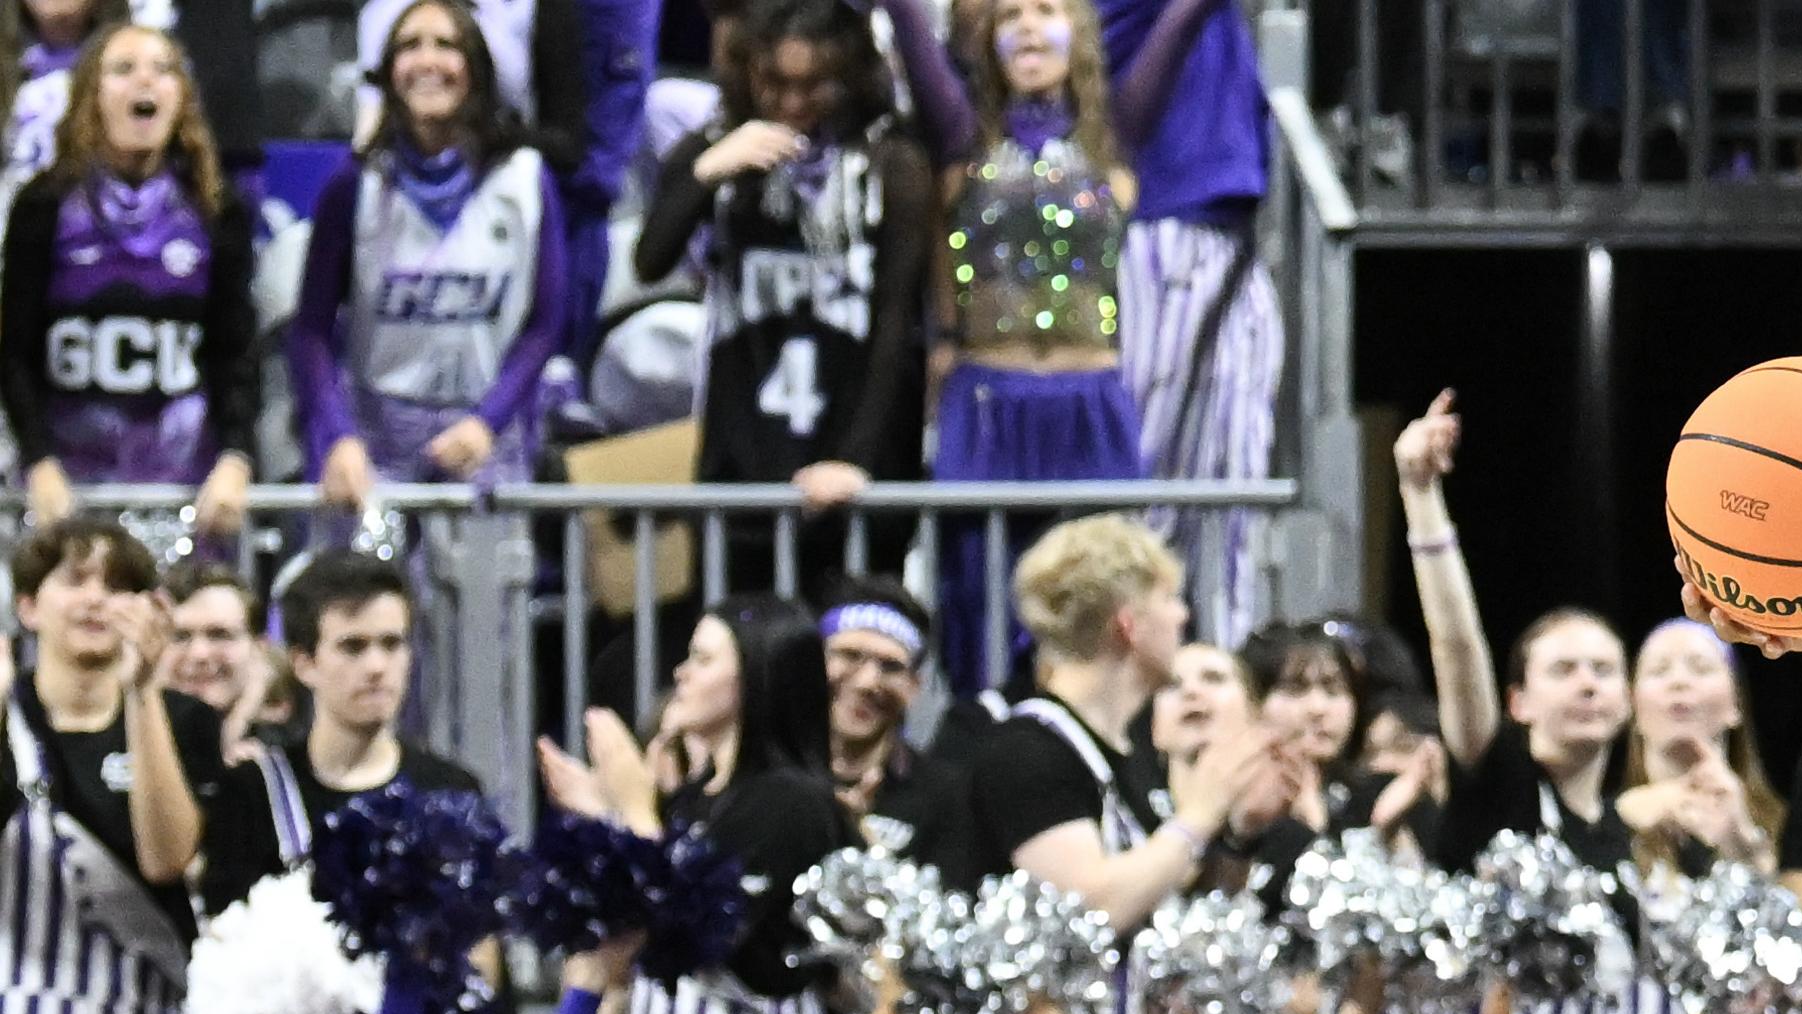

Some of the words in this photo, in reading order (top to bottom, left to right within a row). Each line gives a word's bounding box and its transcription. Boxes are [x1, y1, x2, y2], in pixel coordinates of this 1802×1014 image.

[46, 313, 204, 395] GCU
[758, 336, 826, 436] 4
[1720, 489, 1770, 522] WAC
